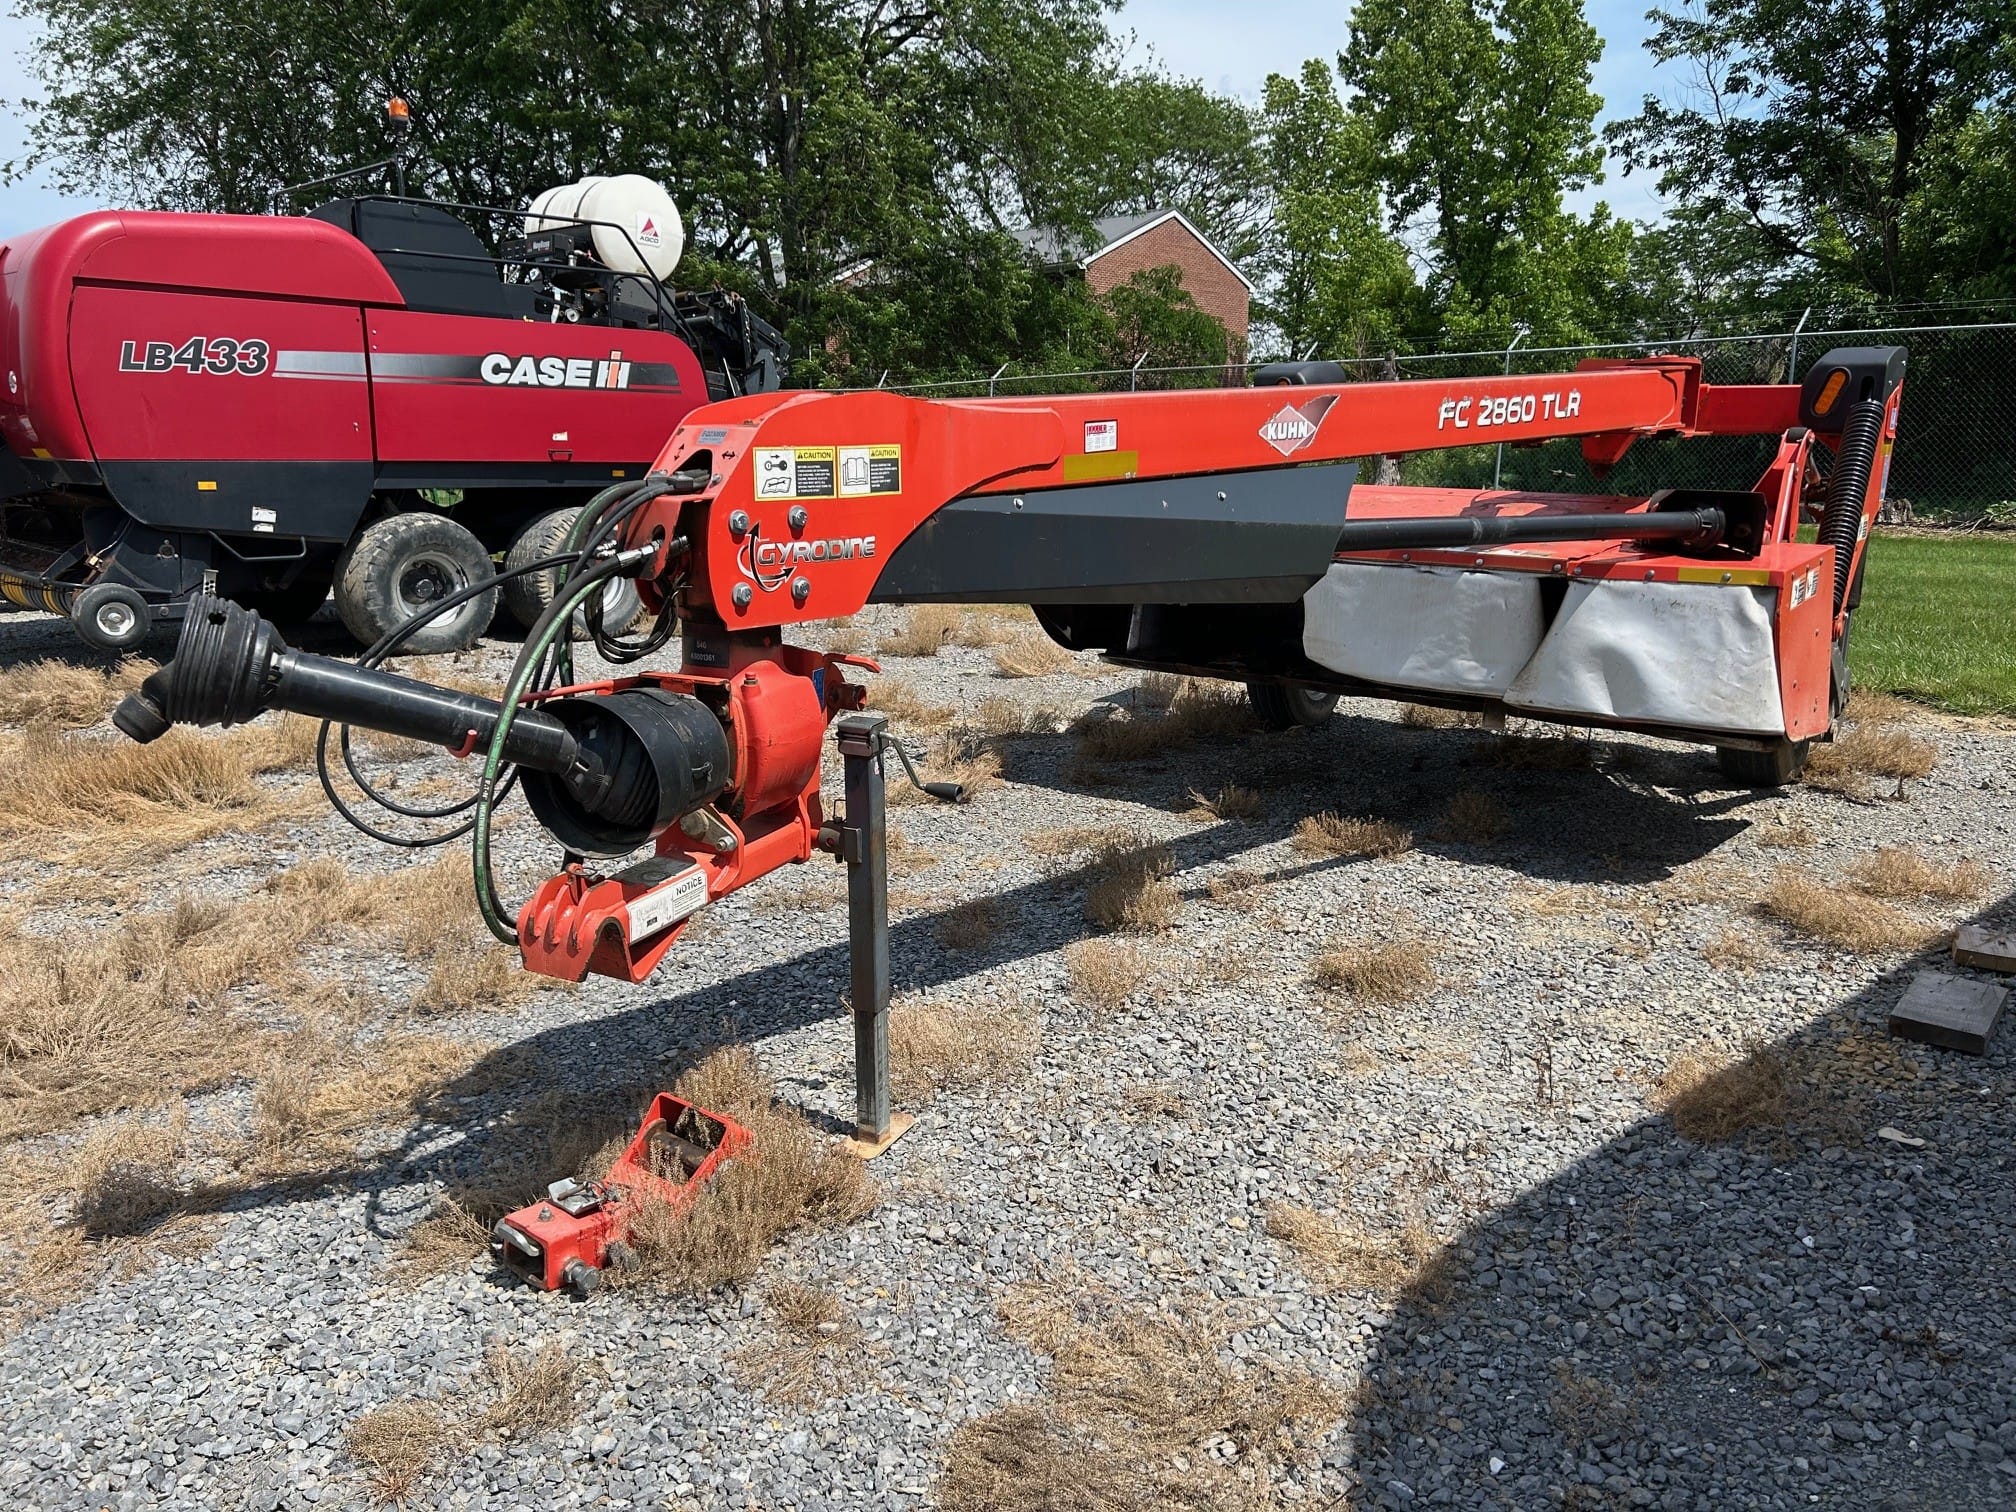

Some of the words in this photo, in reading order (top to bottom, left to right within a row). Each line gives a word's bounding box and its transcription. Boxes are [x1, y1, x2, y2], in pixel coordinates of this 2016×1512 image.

[639, 236, 660, 244] AGCO
[118, 336, 270, 376] LB433
[480, 353, 593, 387] CASE
[1438, 400, 1471, 430] FC
[1476, 399, 1536, 427] 2860
[1542, 391, 1581, 419] TLR
[1267, 420, 1309, 440] KUHN
[803, 451, 832, 459] CAUTION
[874, 449, 897, 457] CAUTION
[757, 535, 876, 566] GYRODINE
[676, 876, 703, 896] NOTICE
